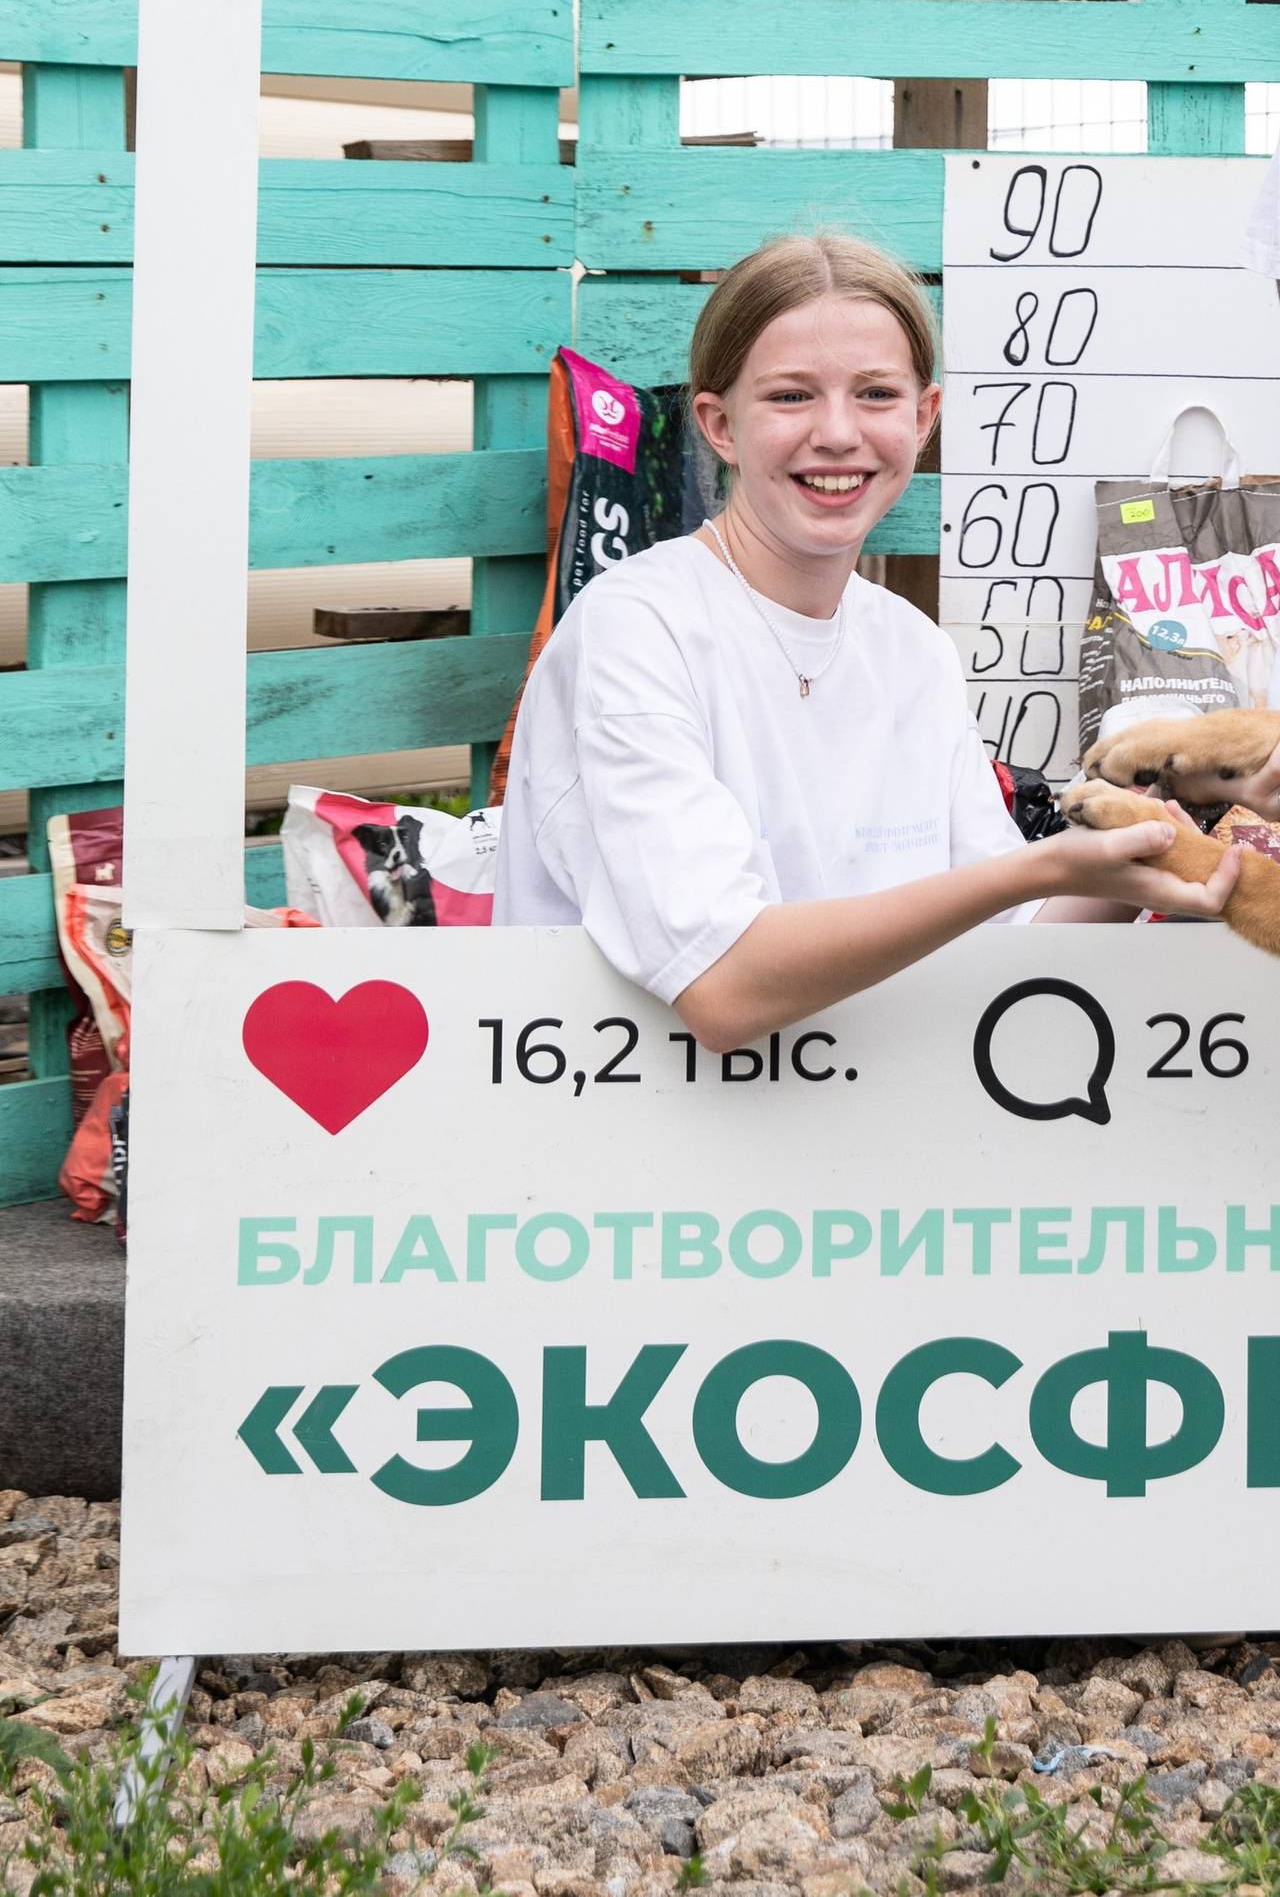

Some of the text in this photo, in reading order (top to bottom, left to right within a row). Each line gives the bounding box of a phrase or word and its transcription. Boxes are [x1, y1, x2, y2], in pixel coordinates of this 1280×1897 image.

[990, 164, 1102, 262] 90
[1003, 288, 1098, 367] 80
[972, 381, 1077, 467] 70
[576, 519, 588, 554] food
[580, 490, 590, 513] for
[958, 483, 1059, 569] 60
[573, 561, 585, 587] pet
[972, 576, 1064, 676] 50
[478, 1017, 858, 1097] 16,2 тыс.
[1145, 1012, 1250, 1079] 26
